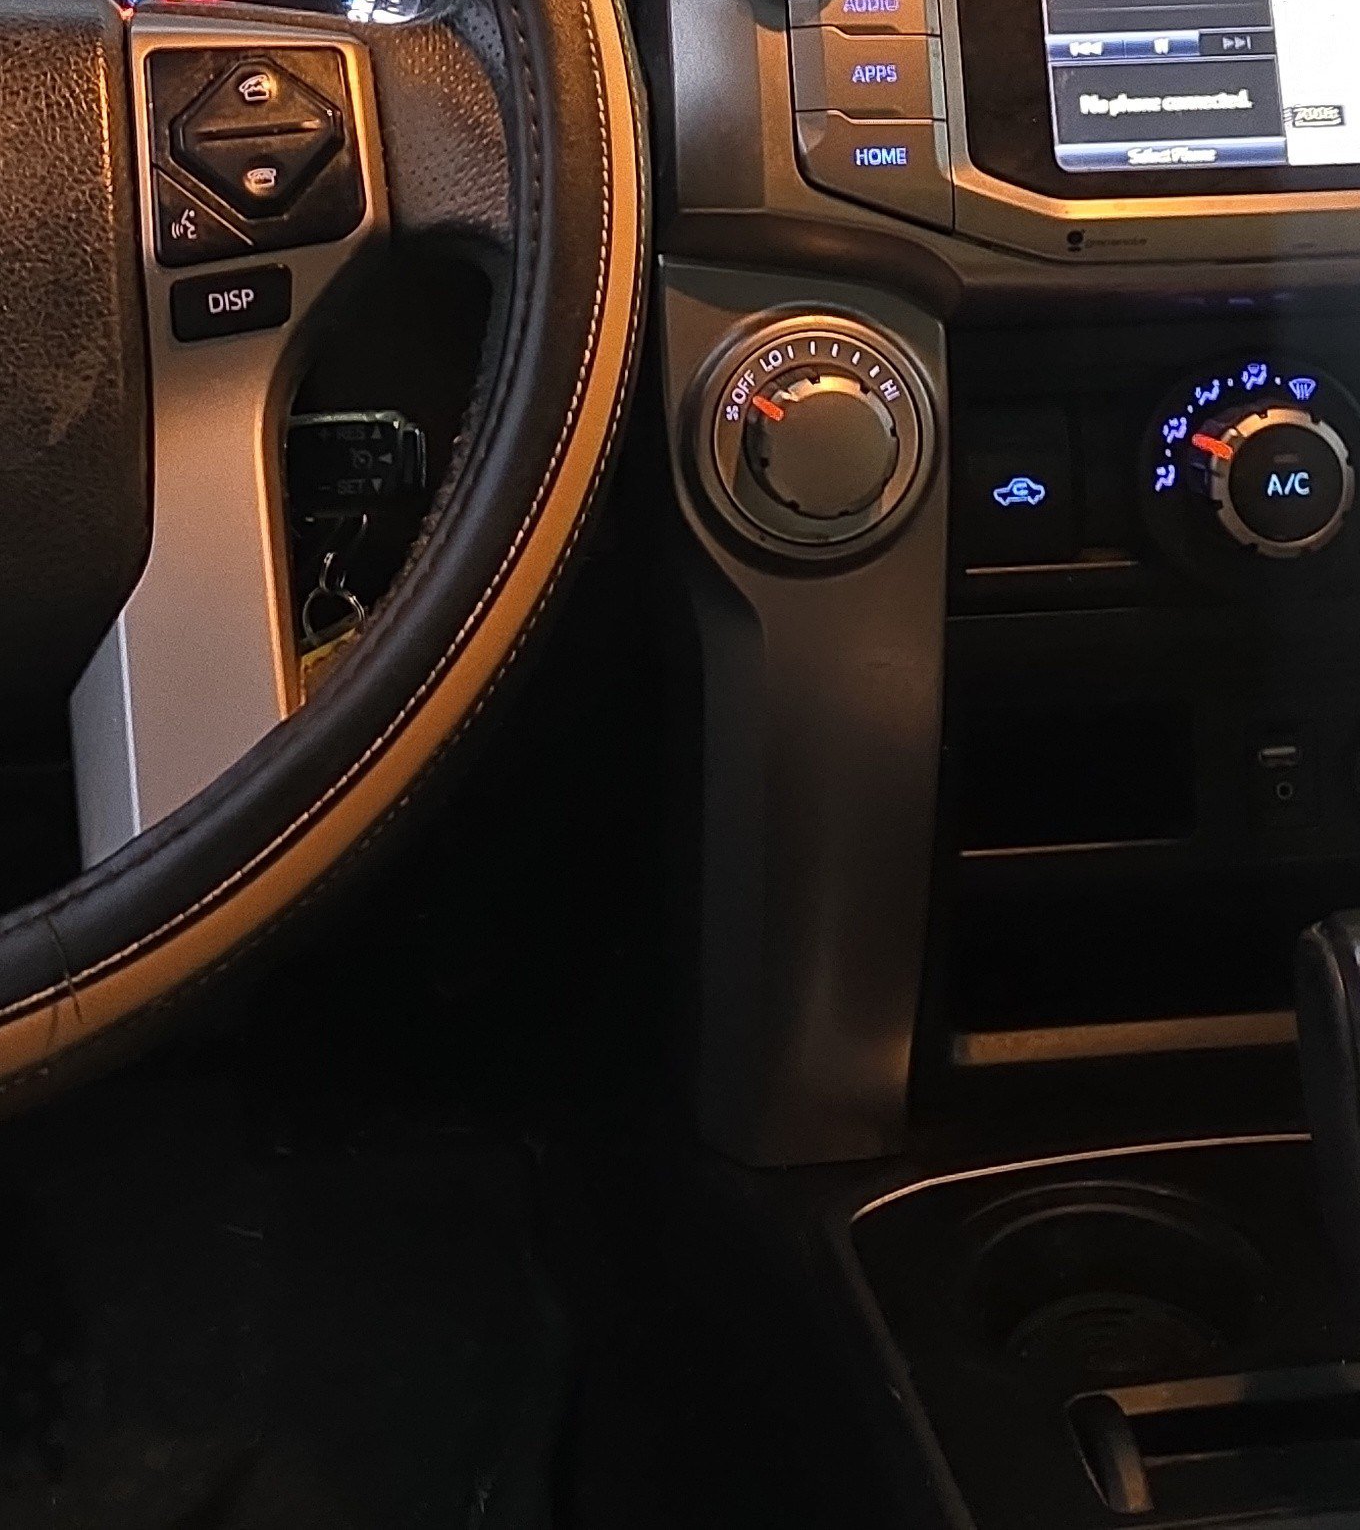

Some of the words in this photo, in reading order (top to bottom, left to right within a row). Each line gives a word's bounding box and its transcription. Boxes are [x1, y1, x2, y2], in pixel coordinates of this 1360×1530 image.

[851, 64, 898, 83] APPS
[1079, 94, 1109, 115] No
[1109, 92, 1161, 117] phone
[855, 147, 908, 166] HOME
[207, 288, 255, 314] DISP
[759, 349, 784, 372] LO
[731, 370, 757, 405] OFF
[879, 378, 901, 402] HI
[1266, 471, 1311, 496] A/C
